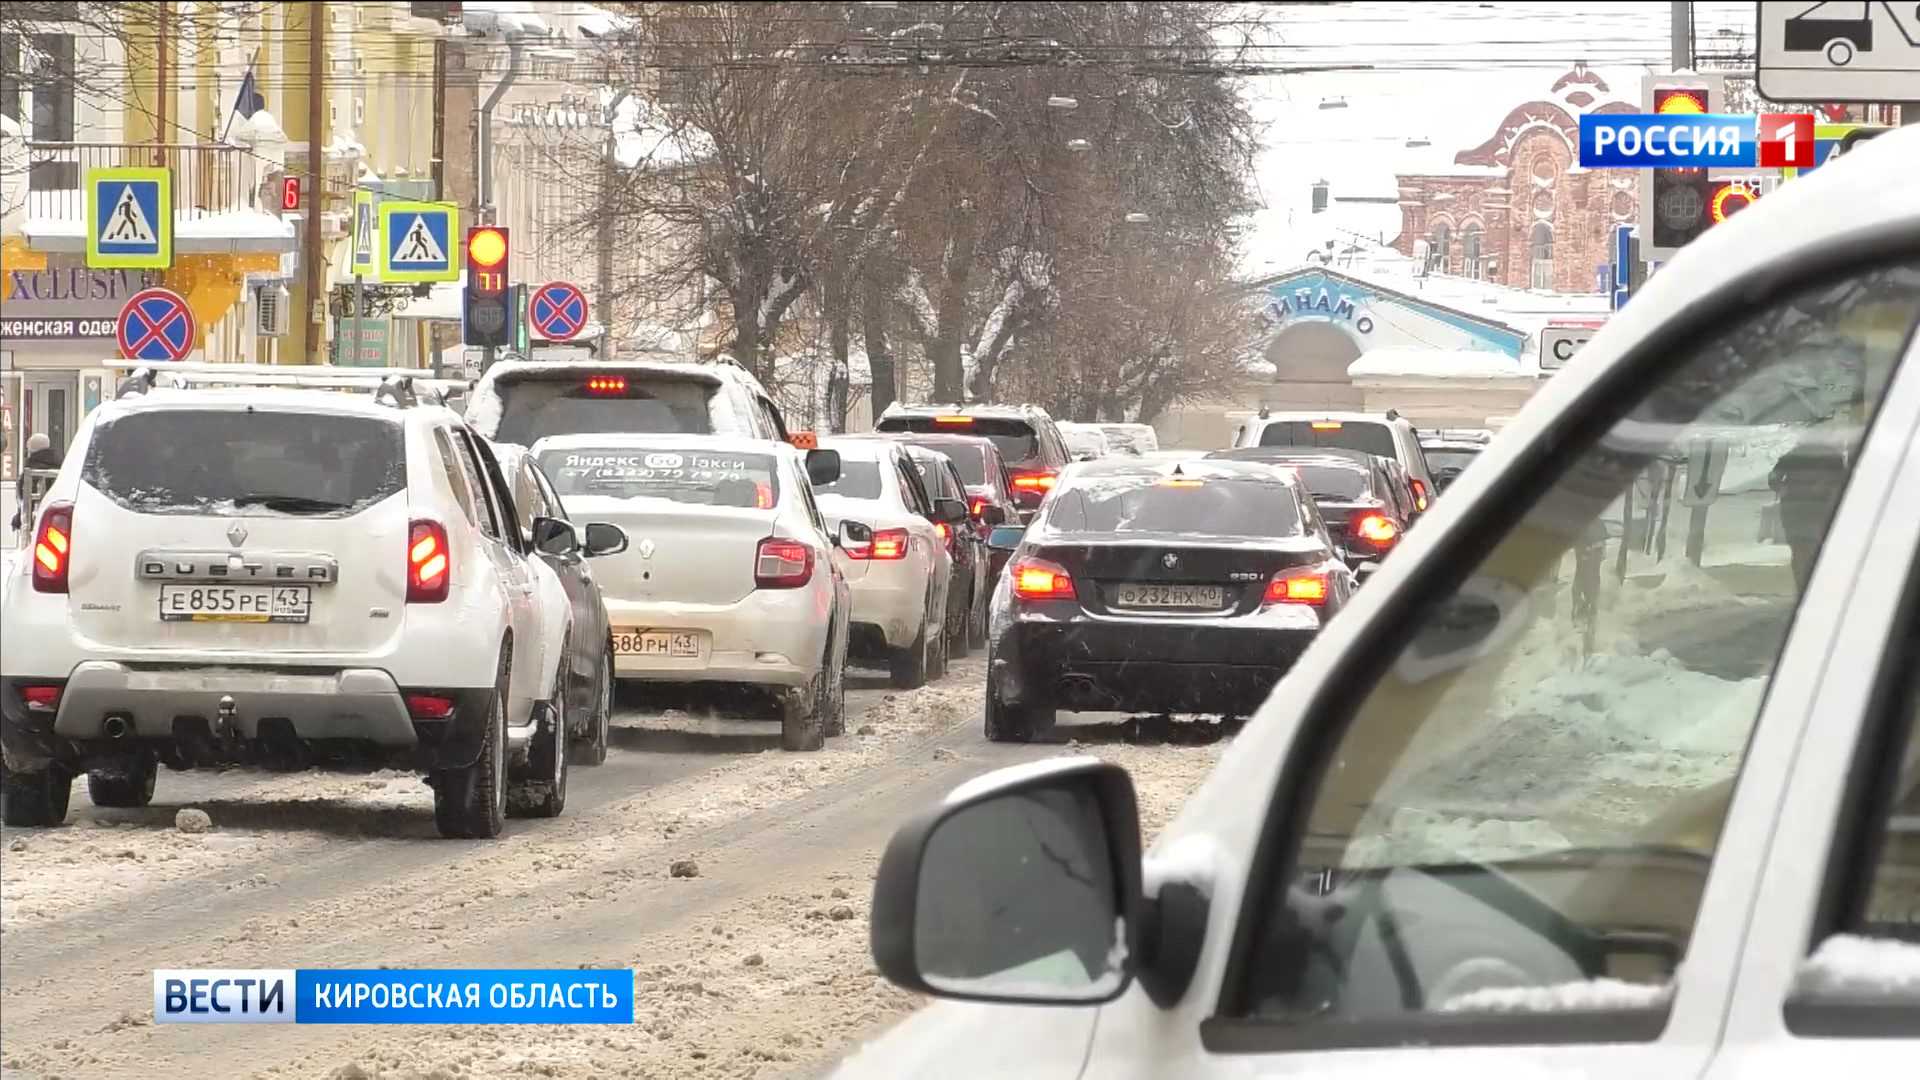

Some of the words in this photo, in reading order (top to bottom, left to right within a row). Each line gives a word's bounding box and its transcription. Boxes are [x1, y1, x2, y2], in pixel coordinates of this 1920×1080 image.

[1267, 288, 1374, 334] ИНАМО
[566, 455, 639, 467] Яндекс
[145, 562, 326, 578] DUSTER
[276, 589, 299, 606] 43
